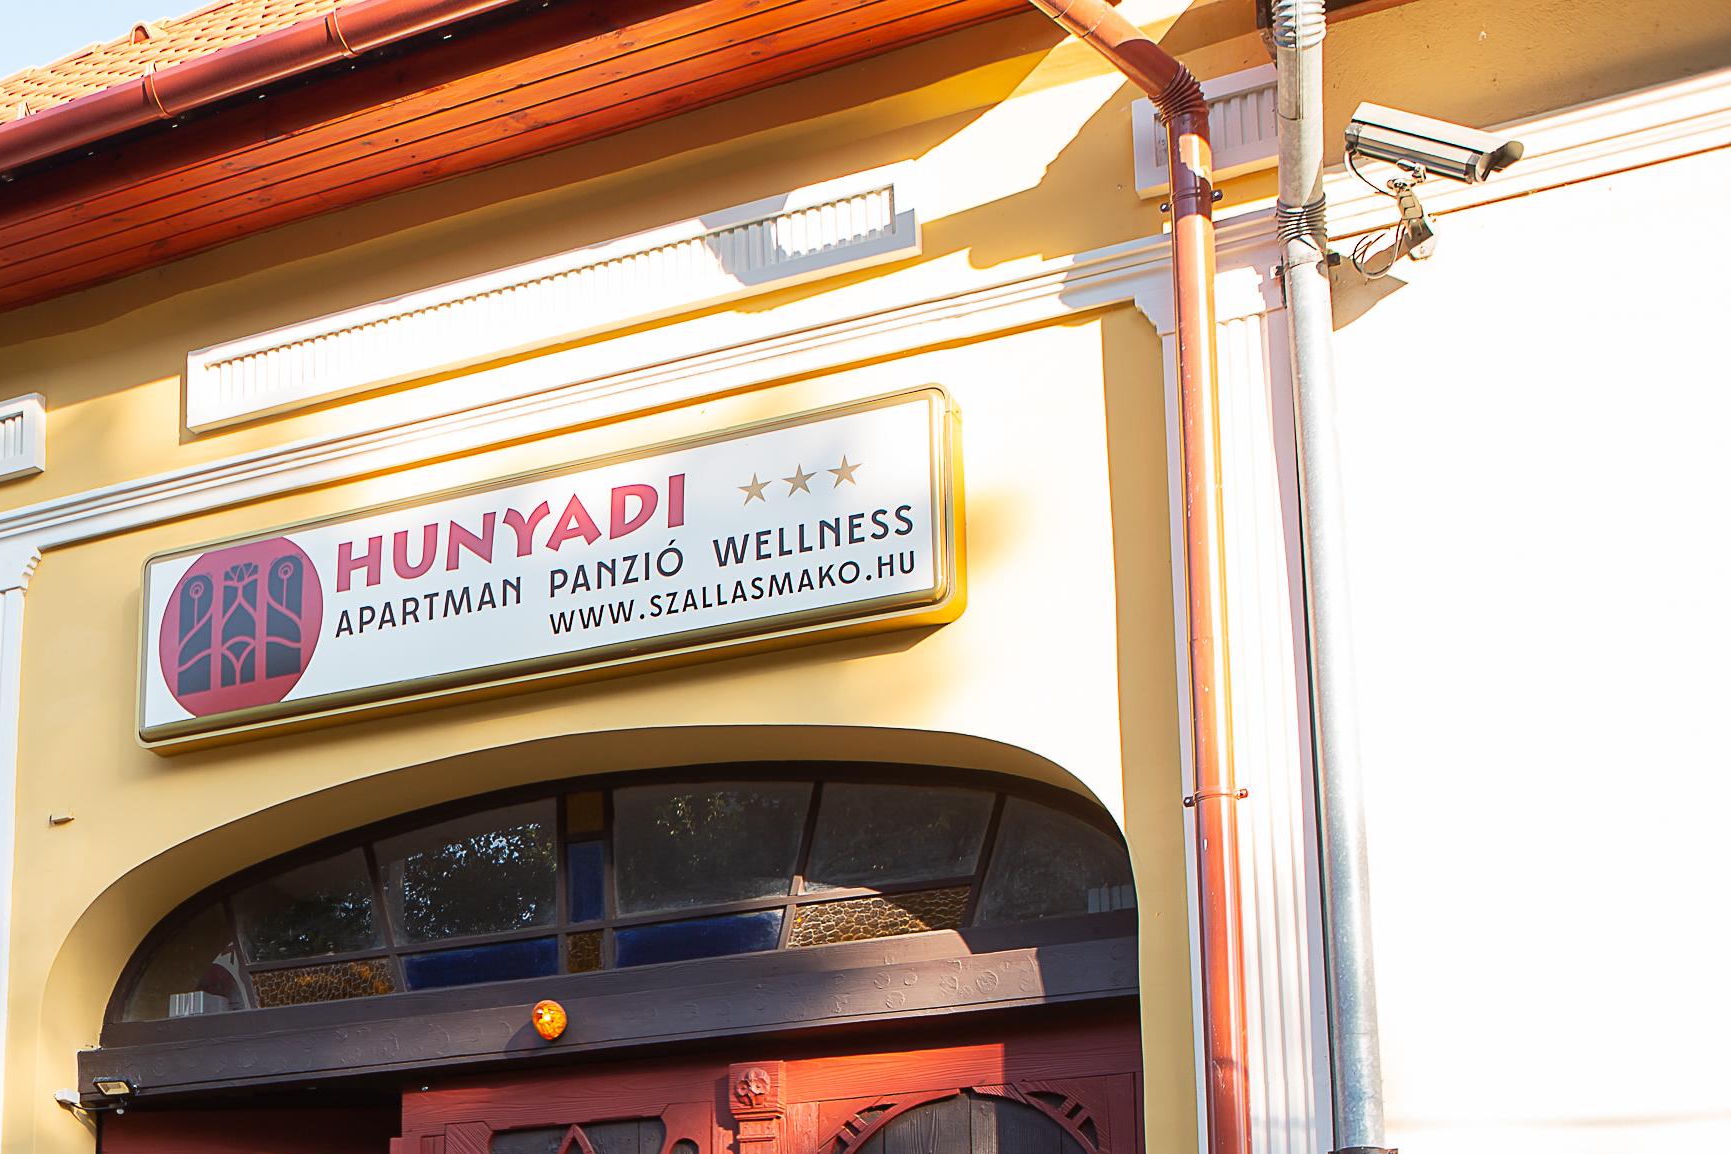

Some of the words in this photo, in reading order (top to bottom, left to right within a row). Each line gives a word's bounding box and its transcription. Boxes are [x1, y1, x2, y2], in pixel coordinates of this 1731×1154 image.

[334, 576, 522, 638] APARTMAN
[549, 539, 684, 598] PANZIÓ
[712, 504, 914, 568] WELLNESS
[336, 473, 686, 593] HUNYADI
[548, 550, 916, 635] WWW.SZALLASMAKO.HU
